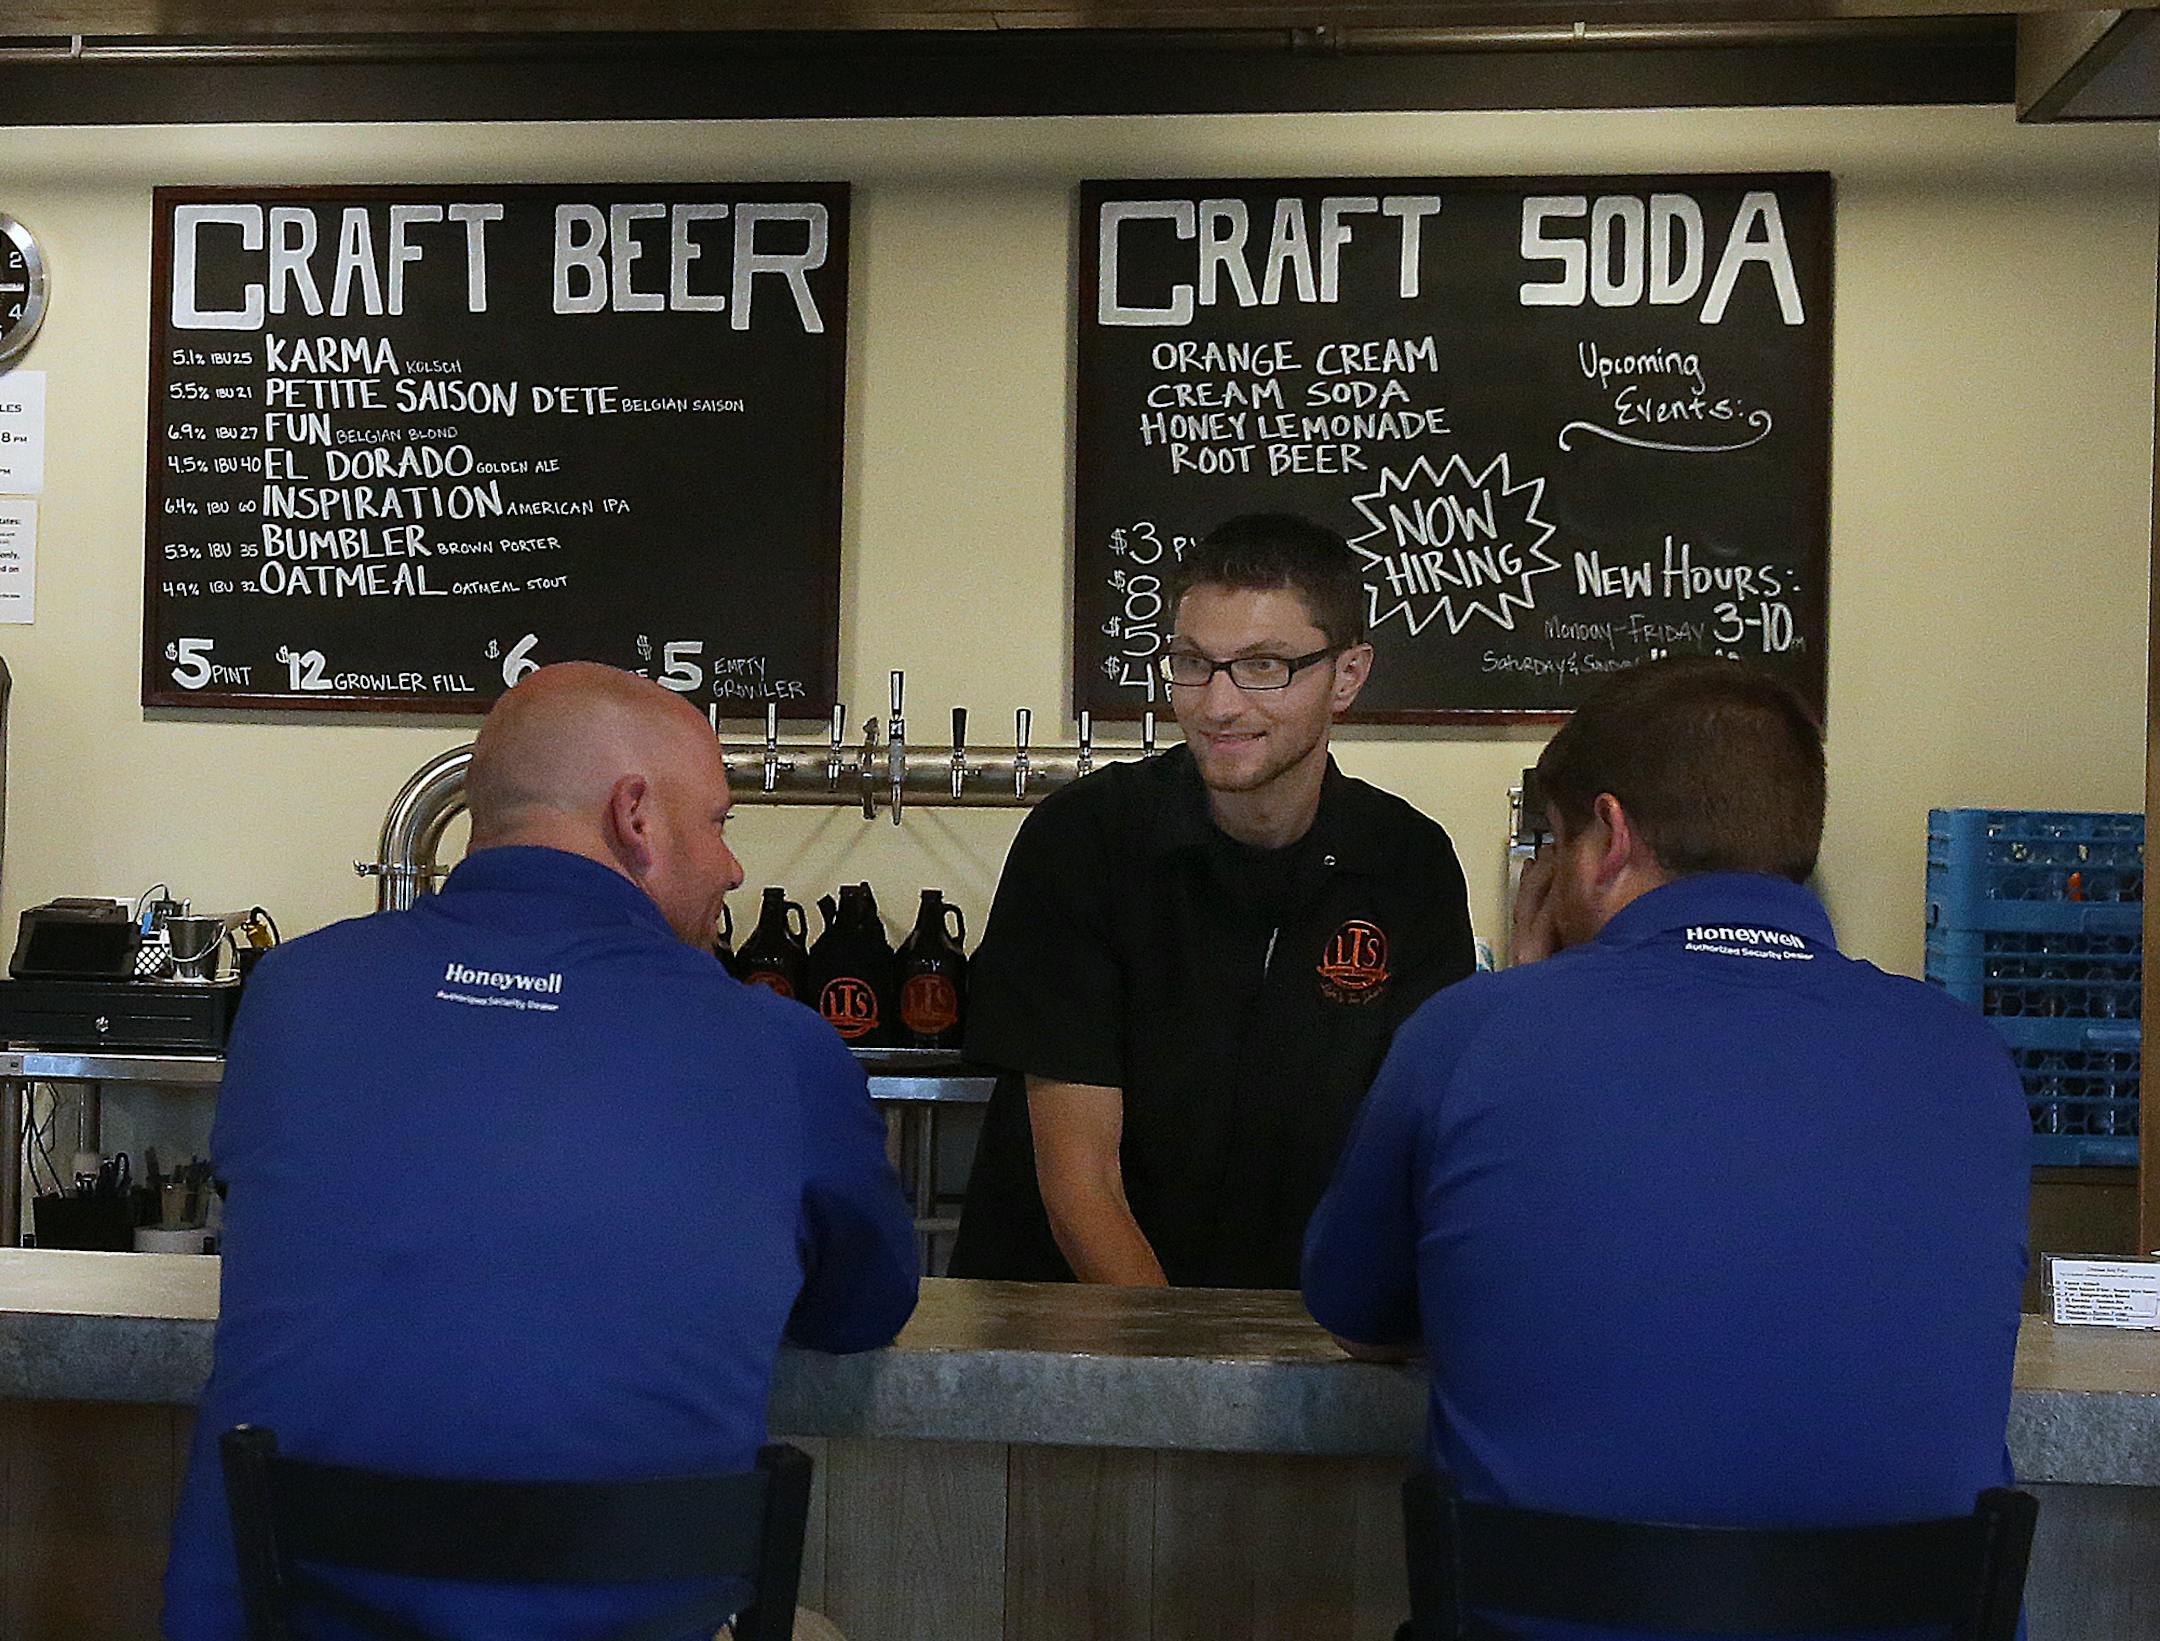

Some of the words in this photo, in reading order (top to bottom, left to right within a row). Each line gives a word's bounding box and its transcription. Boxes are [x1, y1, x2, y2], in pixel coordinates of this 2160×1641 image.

[9, 251, 23, 269] 2
[171, 204, 504, 331] CRAFT
[553, 203, 828, 333] BEER
[1098, 196, 1442, 326] CRAFT
[1519, 191, 1806, 326] SODA
[8, 303, 23, 321] 4
[172, 348, 206, 366] 5.1%
[265, 333, 400, 375] KARMA
[1151, 341, 1302, 377] ORANGE
[1316, 336, 1438, 376] CREAM
[1578, 341, 1706, 395] Upcoming
[169, 382, 210, 400] 5.5%
[265, 377, 387, 410] PETITE
[396, 378, 518, 417] SAISON
[532, 386, 619, 415] D'ETE
[622, 398, 688, 413] BELGIAN
[692, 399, 744, 413] SAISON
[1147, 378, 1285, 410] CREAM
[1306, 379, 1411, 410] SODA
[1614, 385, 1743, 426] Events:
[167, 423, 206, 440] 6.9%
[265, 412, 332, 446] FUN
[336, 427, 402, 443] BELGIAN
[408, 426, 458, 441] BLOND
[1139, 411, 1247, 446] HONEY
[1257, 408, 1451, 441] LEMONADE
[167, 455, 209, 474] 4.5%
[264, 447, 309, 480] EL
[325, 445, 474, 481] DORADO
[476, 460, 528, 475] GOLDEN
[535, 459, 560, 474] ALE
[1170, 442, 1256, 474] ROOT
[1267, 443, 1368, 477] BEER
[206, 501, 230, 515] IBU
[238, 500, 257, 514] 60
[262, 479, 503, 521] INSPIRATION
[506, 500, 594, 516] AMERICAN
[603, 498, 631, 514] IPA
[1388, 489, 1499, 548] NOW
[208, 543, 232, 557] IBU
[240, 543, 259, 557] 35
[261, 524, 432, 560] BUMBLER
[437, 541, 493, 555] BROWN
[500, 536, 561, 553] PORTER
[1108, 521, 1163, 565] $3
[209, 580, 234, 594] IBU
[241, 580, 260, 594] 32
[259, 560, 448, 597] OATMEAL
[452, 579, 520, 595] OATMEAL
[527, 576, 568, 592] STOUT
[1383, 543, 1523, 597] HIRING
[1574, 550, 1652, 599] NEW
[1107, 569, 1162, 621] $8
[1101, 616, 1161, 657] $5
[1713, 602, 1794, 653] 3-10
[165, 637, 214, 690] $5
[212, 665, 252, 687] PINT
[275, 645, 333, 691] $12
[334, 673, 427, 692] GROWLER
[432, 674, 475, 693] FILL
[714, 656, 766, 682] EMPTY
[1100, 655, 1155, 702] $4
[713, 680, 806, 700] GROWLER
[1335, 927, 1380, 968] LTS
[1686, 926, 1806, 950] Honeywell
[445, 963, 563, 994] Honeywell
[829, 984, 868, 1017] LTS
